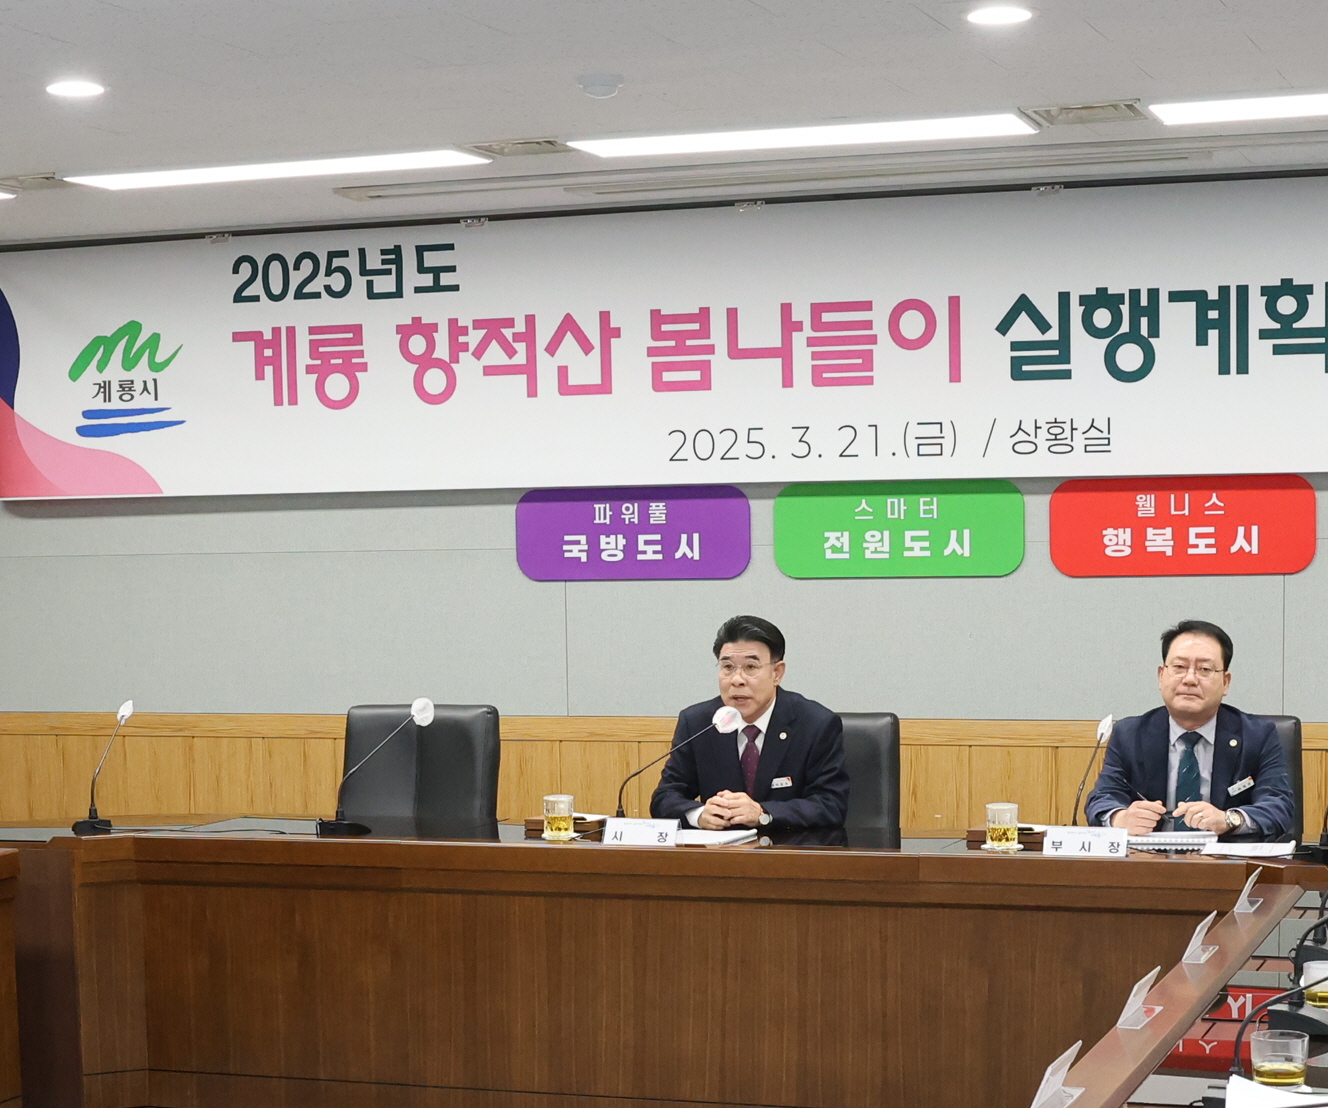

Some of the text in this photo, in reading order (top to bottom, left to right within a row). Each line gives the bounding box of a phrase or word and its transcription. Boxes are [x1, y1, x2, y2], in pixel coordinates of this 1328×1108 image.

[231, 242, 460, 304] 2025년도
[231, 323, 369, 411] 계룡
[395, 310, 622, 406] 향적산
[646, 295, 962, 393] 봄나들이
[92, 378, 159, 403] 계룡시
[667, 427, 777, 462] 2025.
[790, 425, 824, 459] 3.
[837, 420, 958, 459] 21.(금)
[1008, 416, 1113, 456] 상황실
[592, 502, 668, 525] 파워풀
[854, 496, 939, 520] 스마터
[1134, 492, 1226, 518] 웰니스
[562, 532, 701, 563] 국방도시
[823, 528, 972, 560] 전원도시
[1101, 524, 1260, 558] 행복도시
